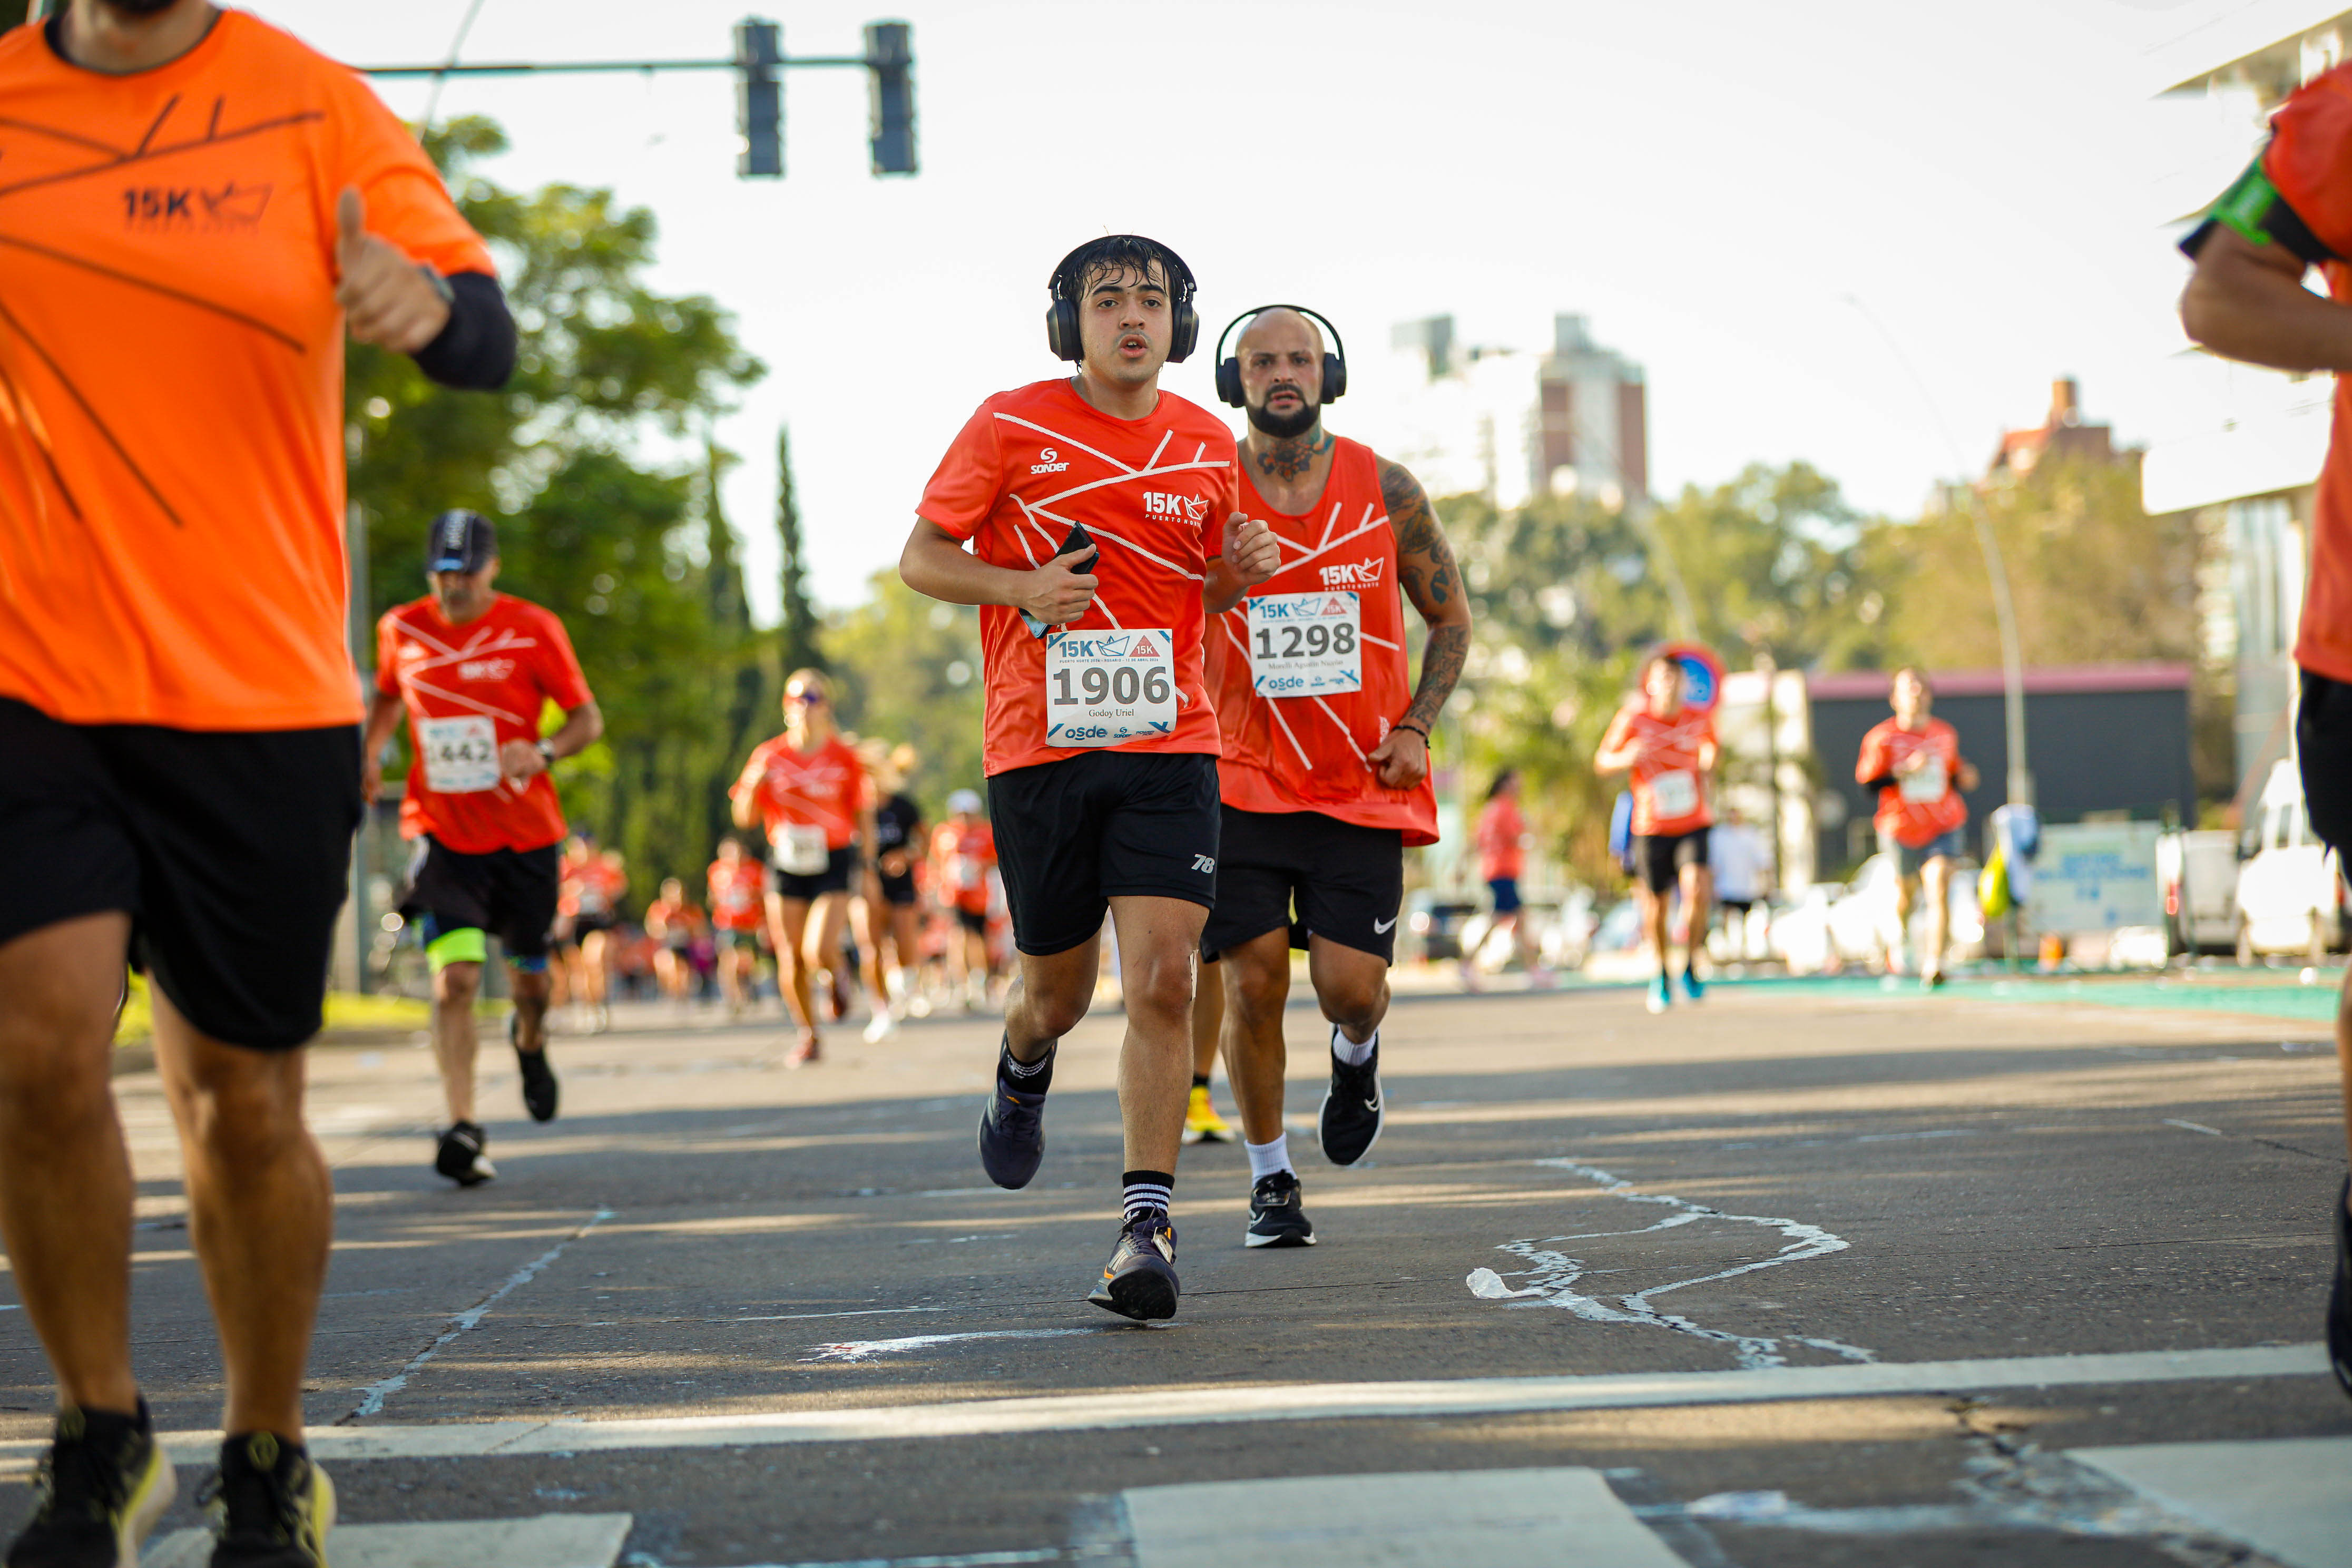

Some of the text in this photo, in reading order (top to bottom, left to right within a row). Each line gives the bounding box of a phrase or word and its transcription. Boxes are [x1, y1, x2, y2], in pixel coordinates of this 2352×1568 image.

[1143, 492, 1182, 515] 15K
[1145, 514, 1181, 523] PUERTO
[1319, 563, 1356, 586] 15K
[1260, 603, 1289, 618] 15K
[1059, 640, 1094, 657] 15K
[1256, 623, 1355, 659] 1298
[1136, 645, 1153, 654] 15K
[1054, 667, 1170, 705] 1906
[1269, 675, 1304, 688] osde
[1089, 709, 1113, 718] Godoy
[1065, 725, 1108, 739] osde
[1191, 854, 1215, 874] 78
